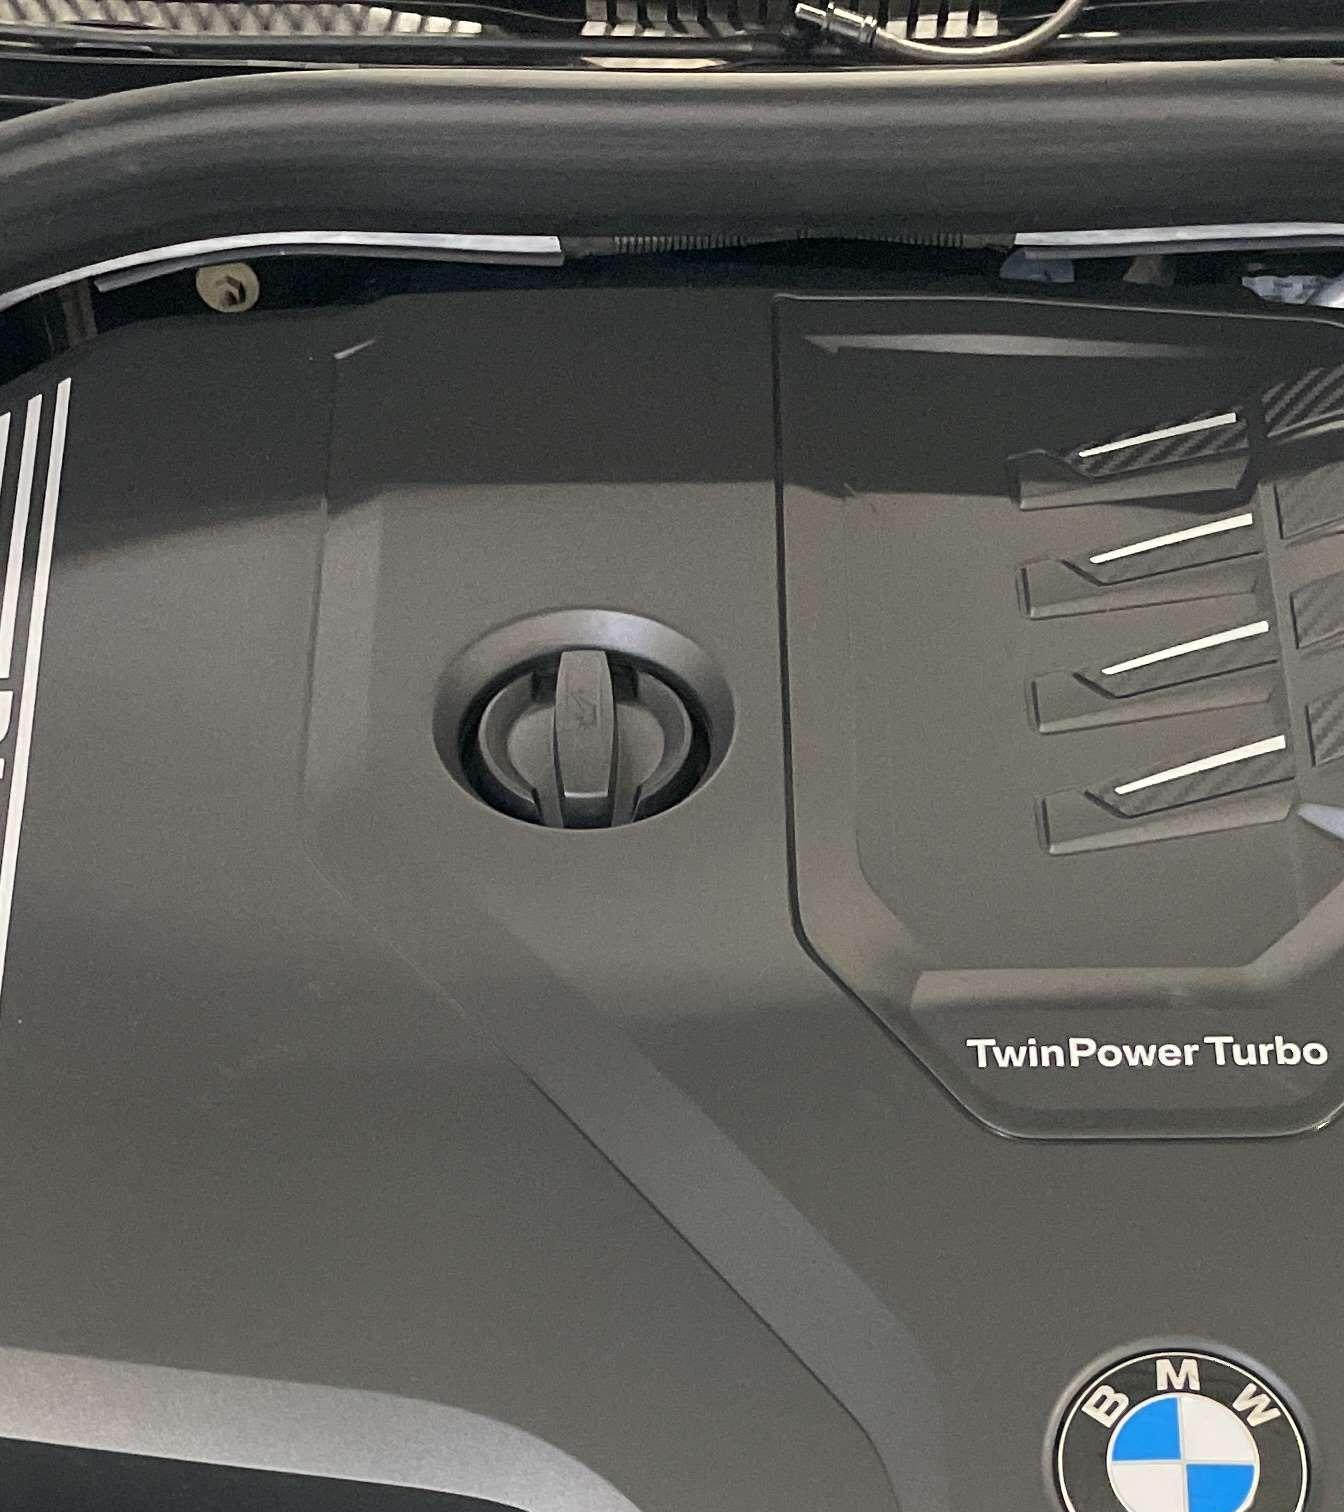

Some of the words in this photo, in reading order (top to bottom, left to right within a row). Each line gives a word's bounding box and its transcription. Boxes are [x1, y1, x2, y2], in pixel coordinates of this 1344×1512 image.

[966, 1037, 1200, 1068] TwinPower
[1203, 1035, 1329, 1066] Turbo
[1081, 1358, 1281, 1428] BMW
